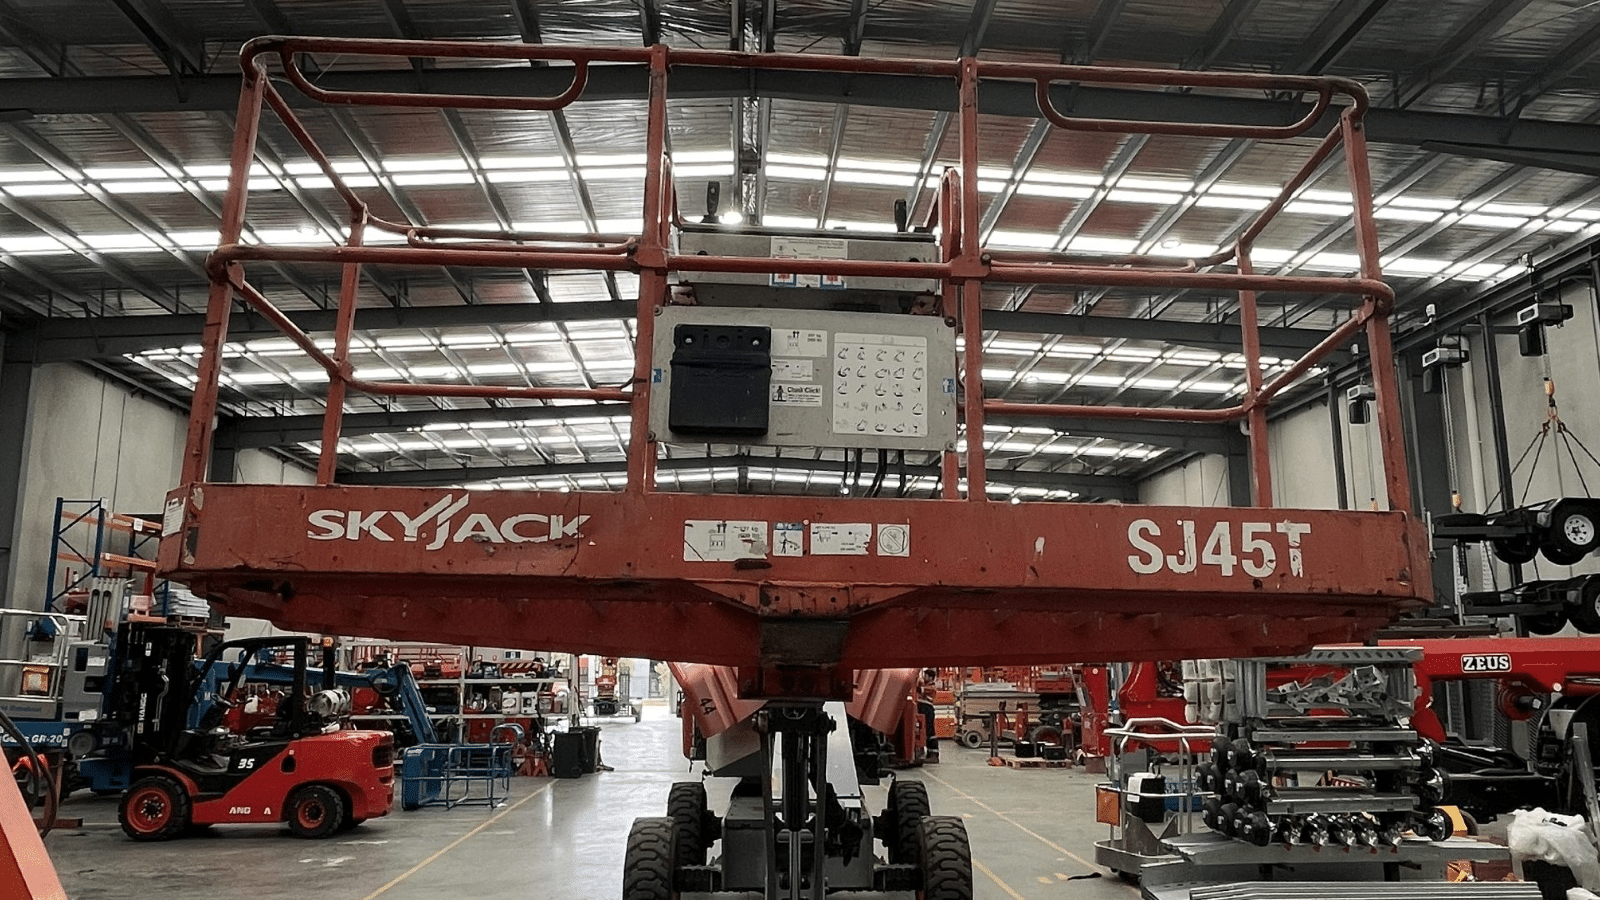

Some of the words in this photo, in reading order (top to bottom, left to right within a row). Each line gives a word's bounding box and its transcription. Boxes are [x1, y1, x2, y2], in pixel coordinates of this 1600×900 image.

[307, 493, 592, 551] SKYJACK
[1127, 518, 1312, 578] SJ45T
[1463, 656, 1509, 671] ZEUS
[700, 698, 717, 715] 44
[238, 758, 255, 769] 35
